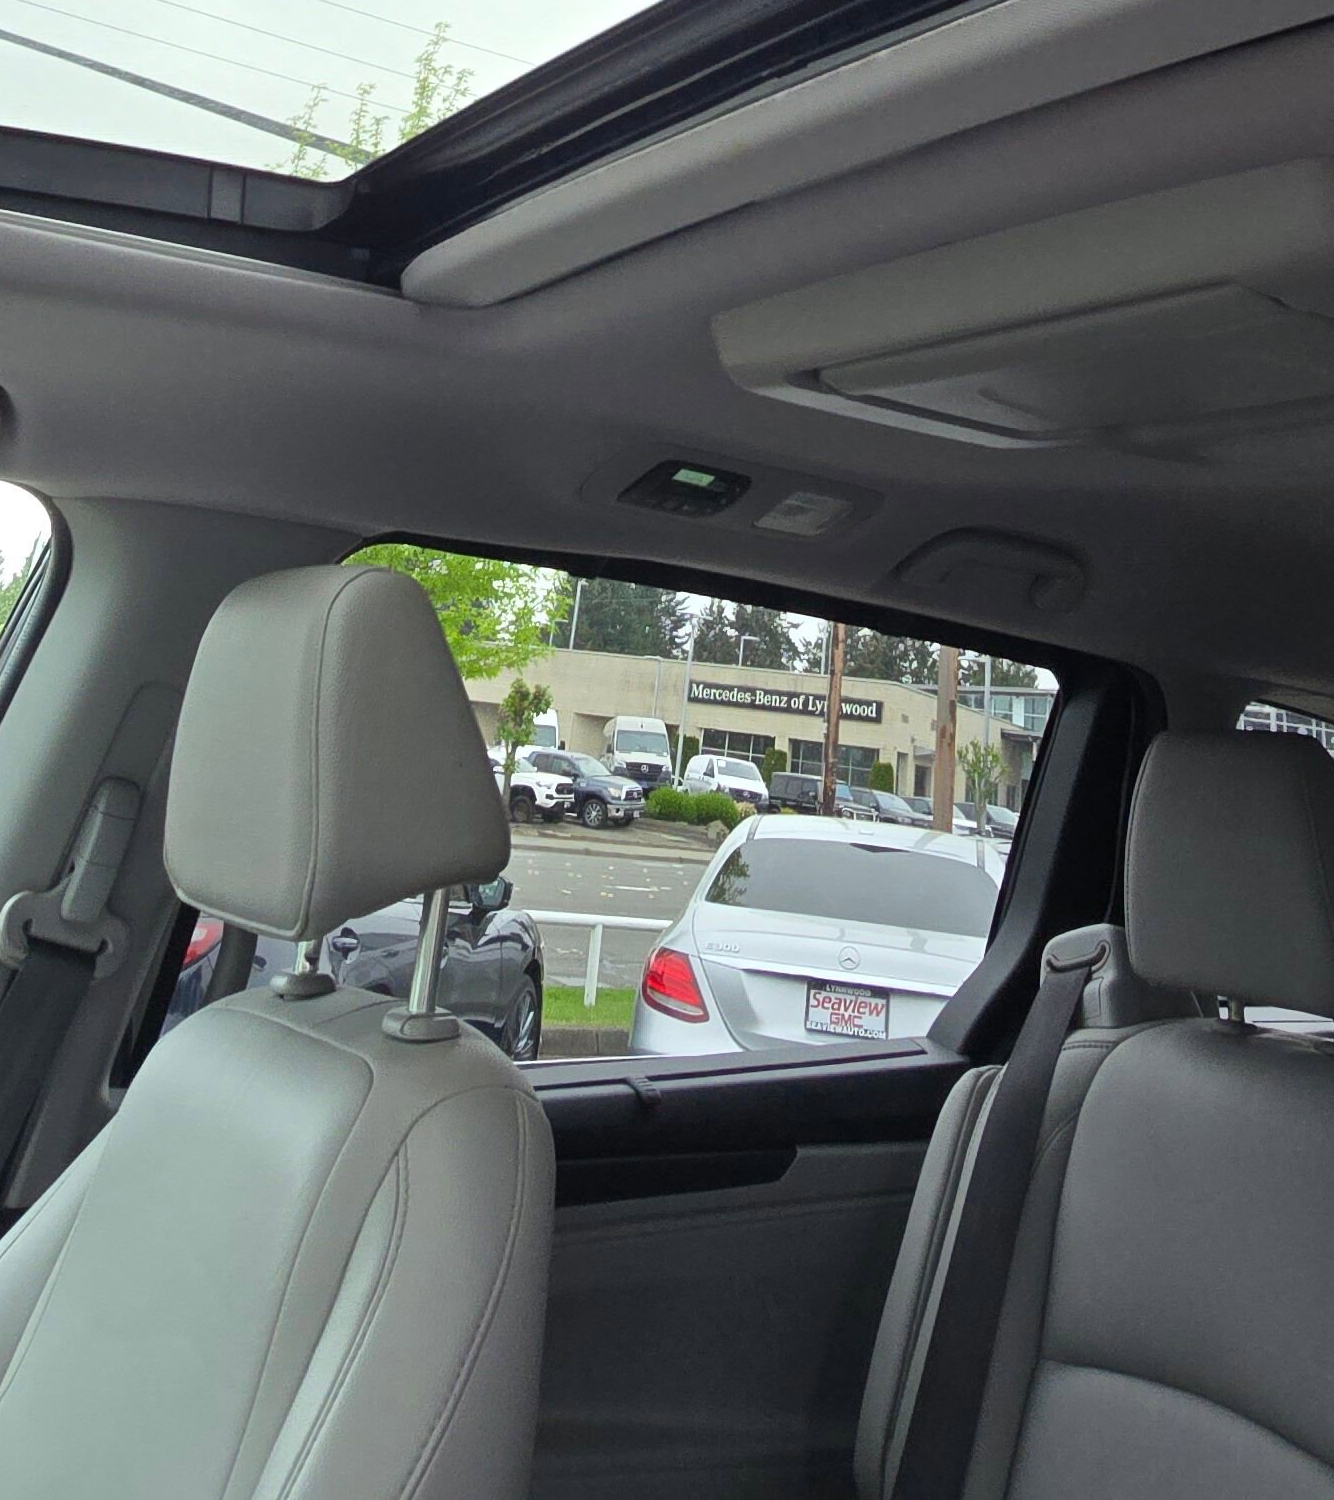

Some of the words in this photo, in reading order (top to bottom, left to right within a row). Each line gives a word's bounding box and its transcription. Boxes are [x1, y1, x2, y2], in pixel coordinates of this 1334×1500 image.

[690, 683, 788, 708] Mercedes-Benz
[790, 695, 806, 710] of
[810, 991, 885, 1018] Seaview
[829, 1011, 864, 1029] GMC
